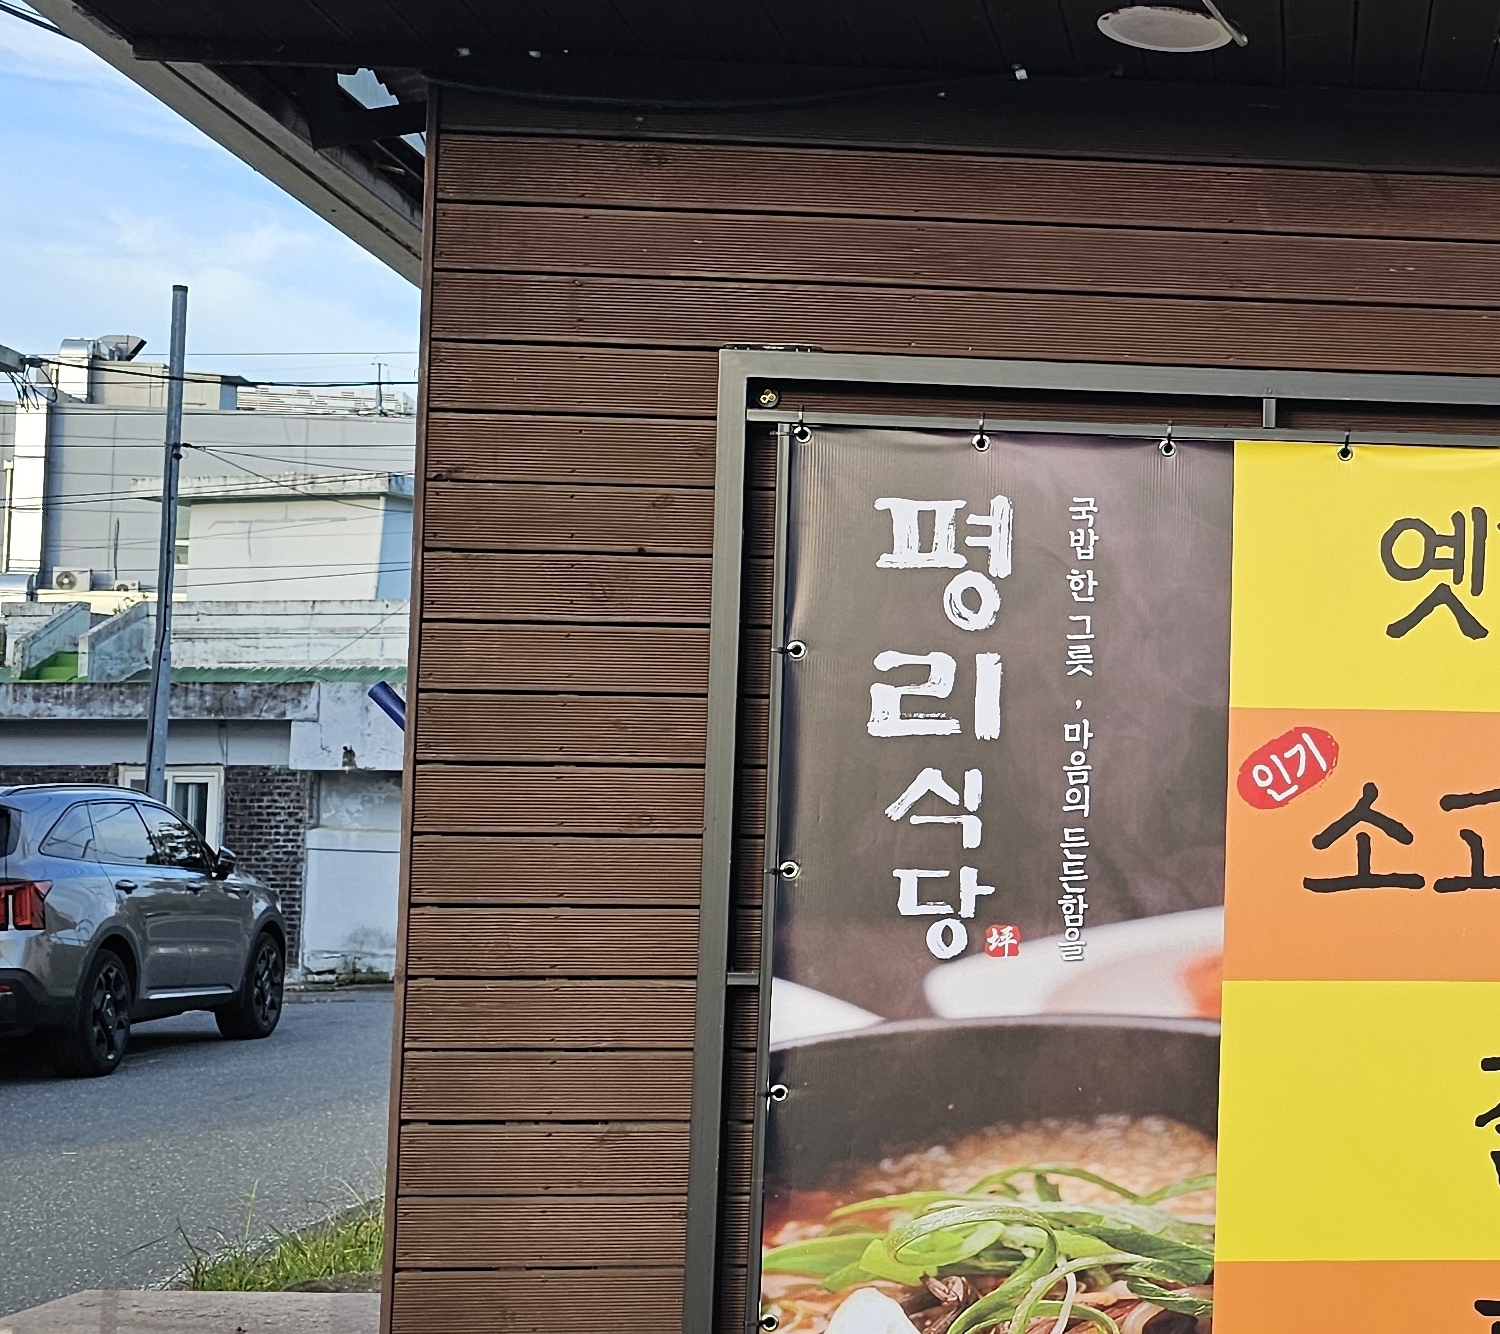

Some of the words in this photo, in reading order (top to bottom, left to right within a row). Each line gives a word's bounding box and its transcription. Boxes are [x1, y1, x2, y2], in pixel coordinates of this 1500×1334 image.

[1068, 495, 1099, 561] 국밥
[1066, 569, 1099, 604] 한
[867, 494, 1014, 961] 평리식당
[1062, 718, 1094, 819] 마음의
[1252, 732, 1327, 802] 인기
[1057, 827, 1091, 962] 든든함을
